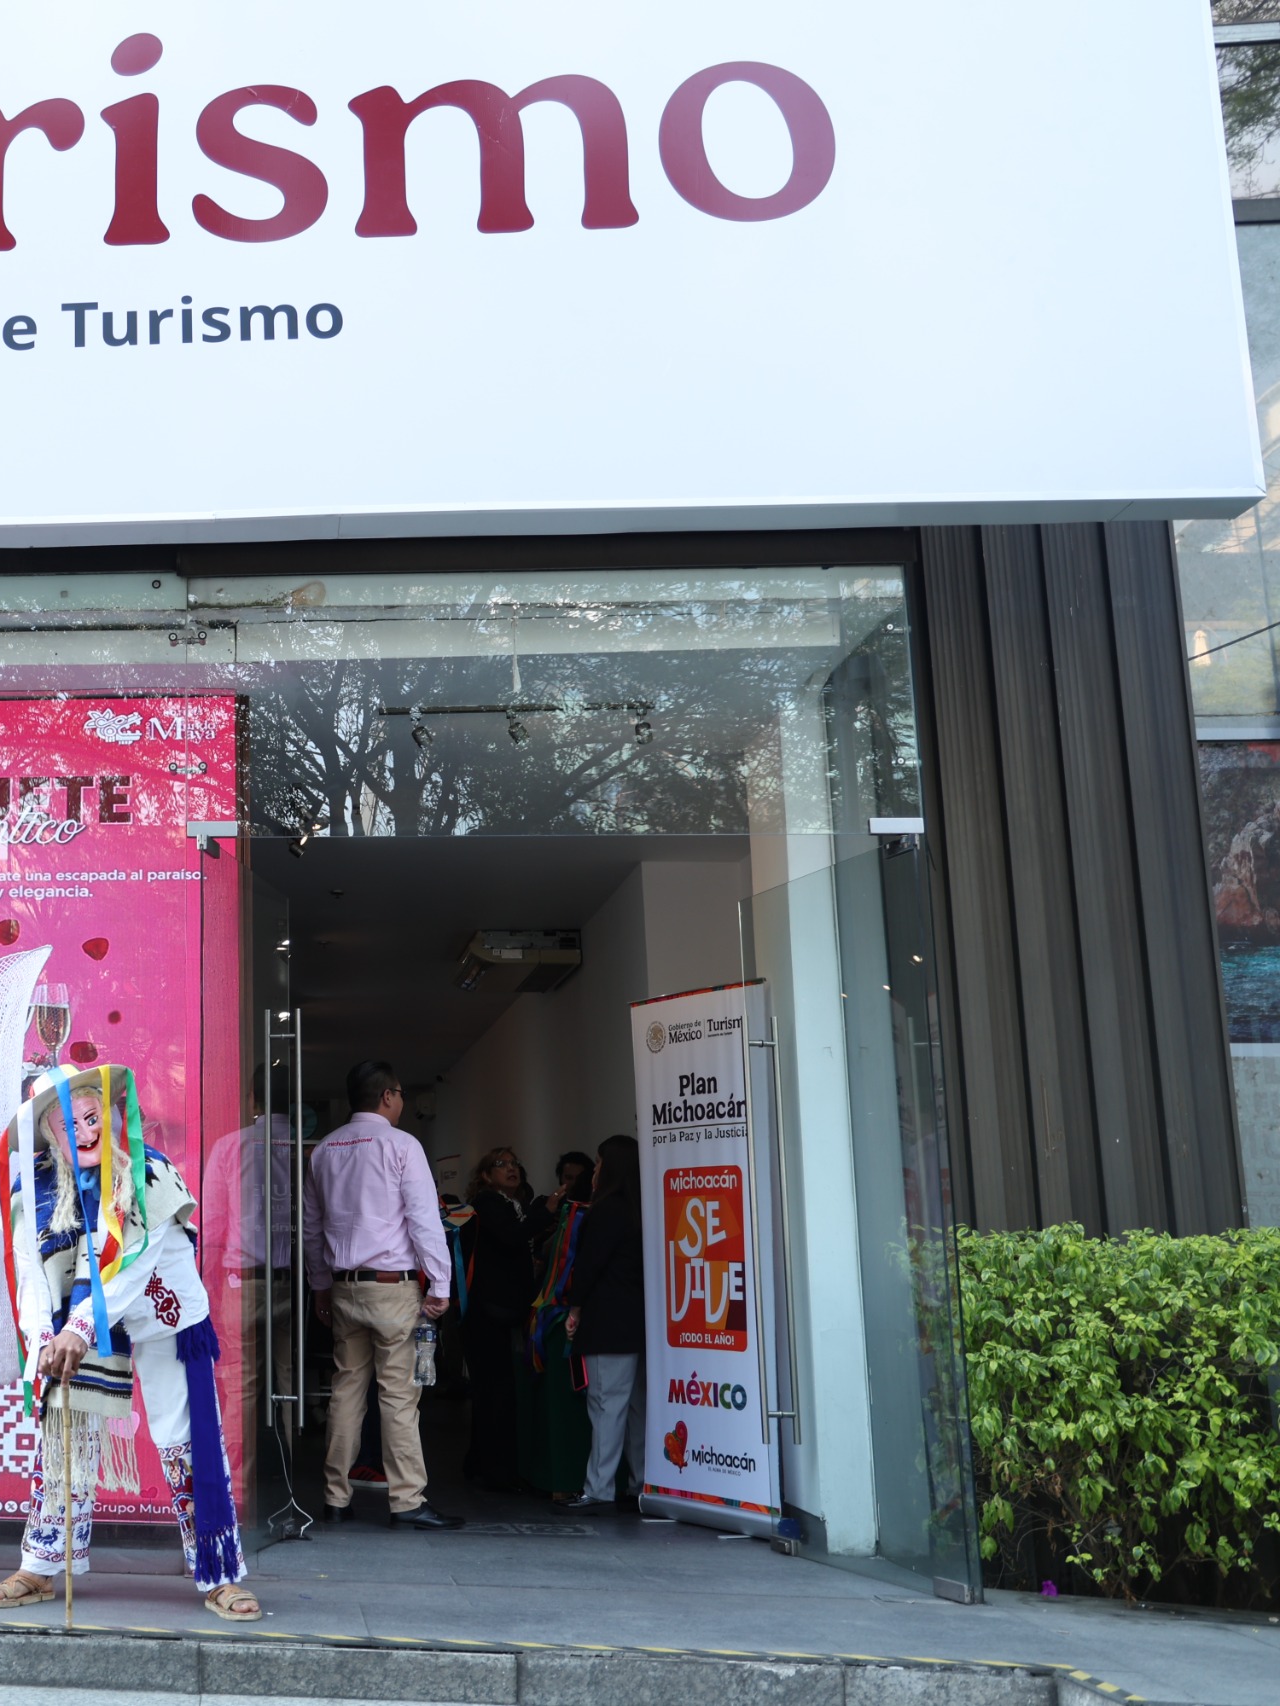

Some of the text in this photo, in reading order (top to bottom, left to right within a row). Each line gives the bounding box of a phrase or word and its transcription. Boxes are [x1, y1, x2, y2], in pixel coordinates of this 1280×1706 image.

[61, 295, 343, 348] Turismo
[25, 871, 52, 882] una
[56, 869, 126, 883] escapada
[130, 869, 143, 881] al
[147, 869, 208, 882] paraíso.
[8, 885, 94, 900] elegancia.
[668, 1021, 693, 1031] Gobierno
[707, 1016, 742, 1032] Turism
[668, 1030, 702, 1044] México
[679, 1072, 718, 1097] Plan
[652, 1093, 747, 1126] Michoacán
[652, 1135, 667, 1147] por
[669, 1132, 677, 1142] la
[679, 1131, 694, 1142] Paz
[695, 1132, 701, 1143] y
[704, 1128, 713, 1139] la
[670, 1169, 738, 1193] Michoacán
[678, 1197, 727, 1258] SE
[679, 1331, 735, 1346] ¡TODO EL AÑO!
[692, 1444, 756, 1473] Michoacán
[92, 1502, 136, 1515] Grupo
